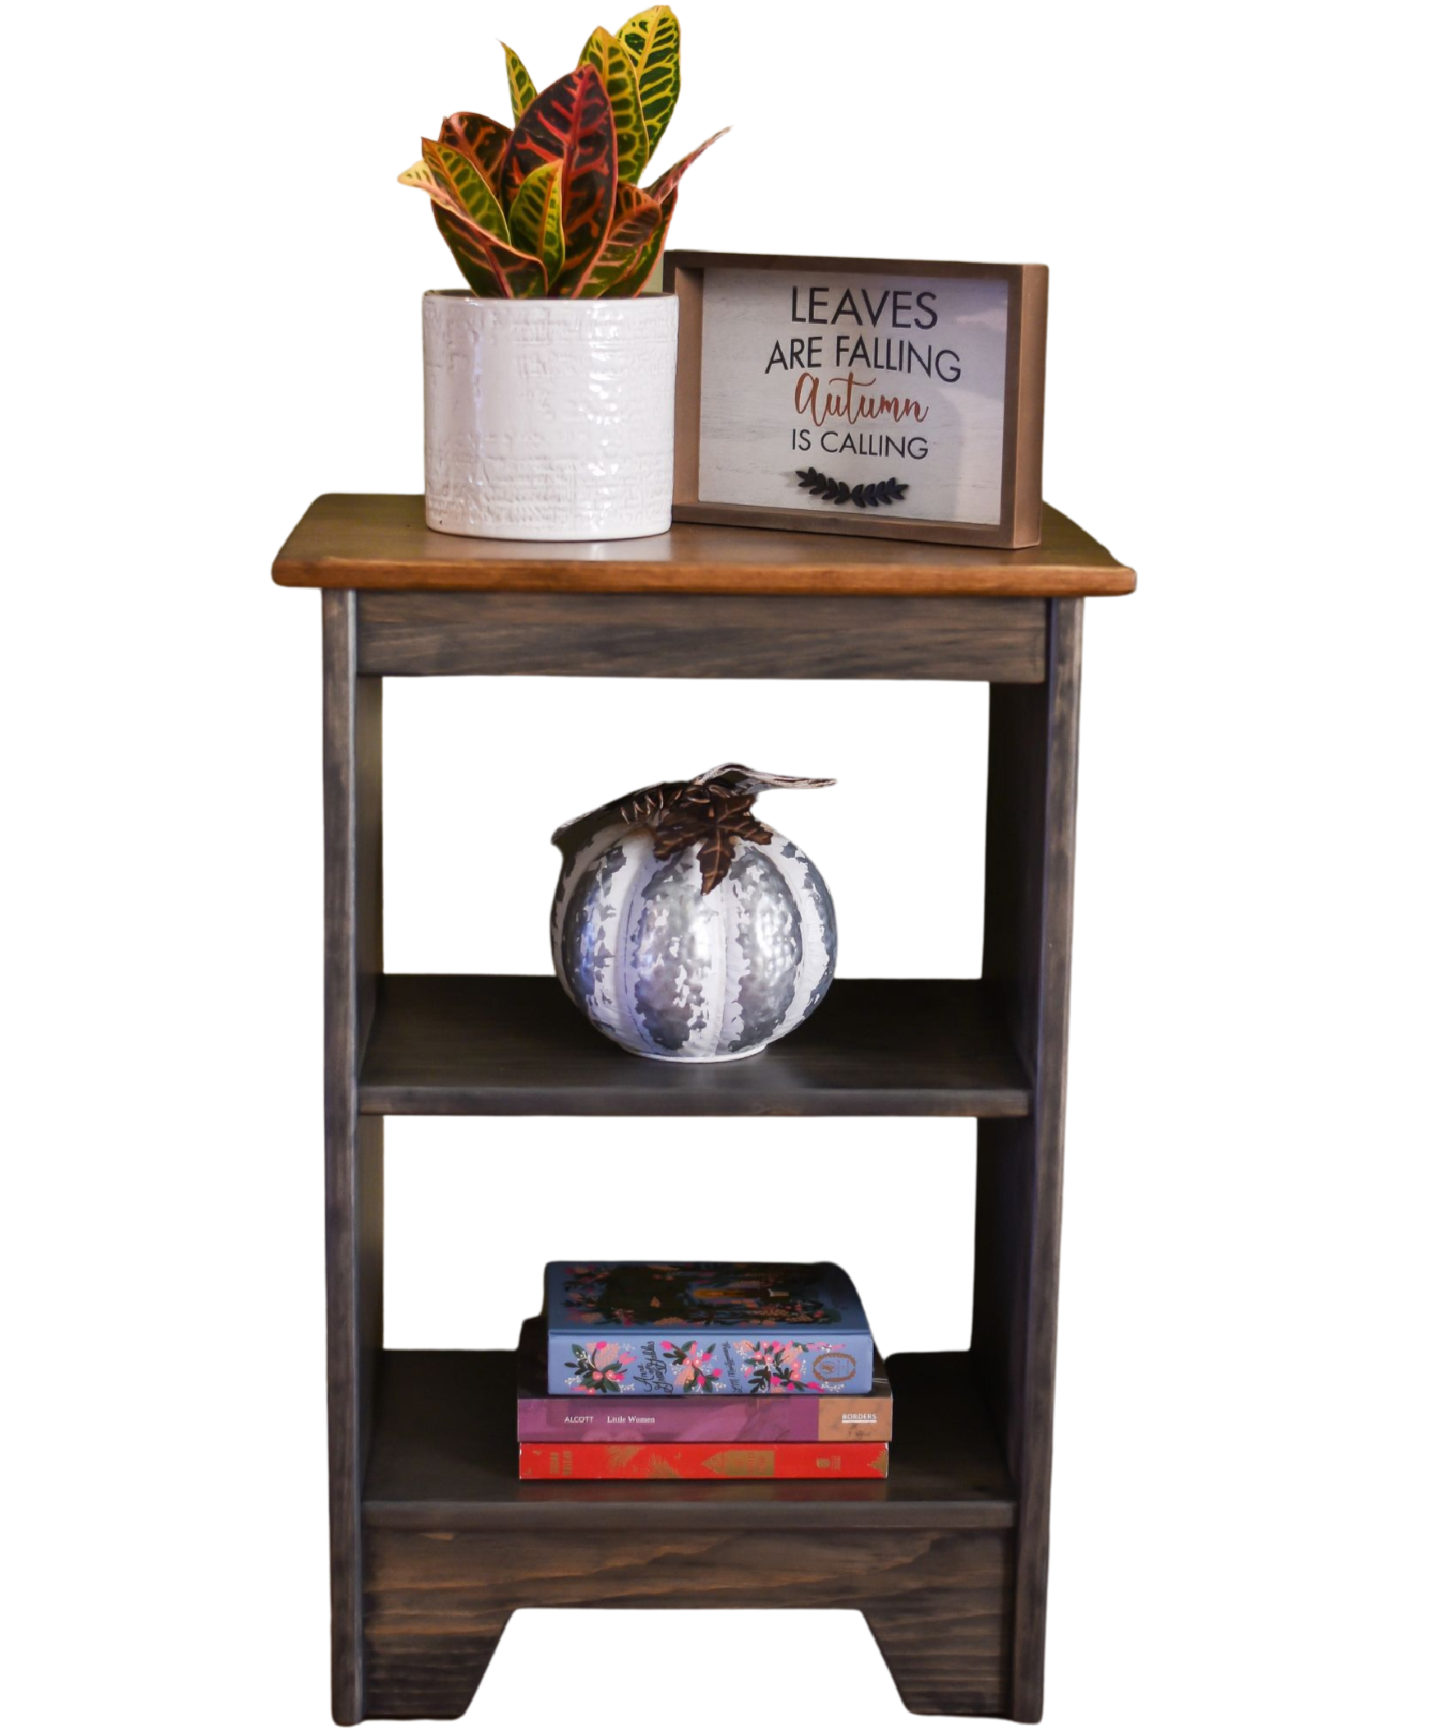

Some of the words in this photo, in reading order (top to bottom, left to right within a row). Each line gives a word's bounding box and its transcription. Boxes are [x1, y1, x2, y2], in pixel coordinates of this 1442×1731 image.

[791, 284, 938, 330] LEAVES
[765, 336, 822, 375] ARE
[835, 335, 962, 383] FALLING
[792, 428, 811, 451] IS
[820, 430, 929, 460] CALLING
[564, 1416, 594, 1424] ALCOTT
[606, 1415, 626, 1424] Little
[627, 1416, 656, 1424] Women
